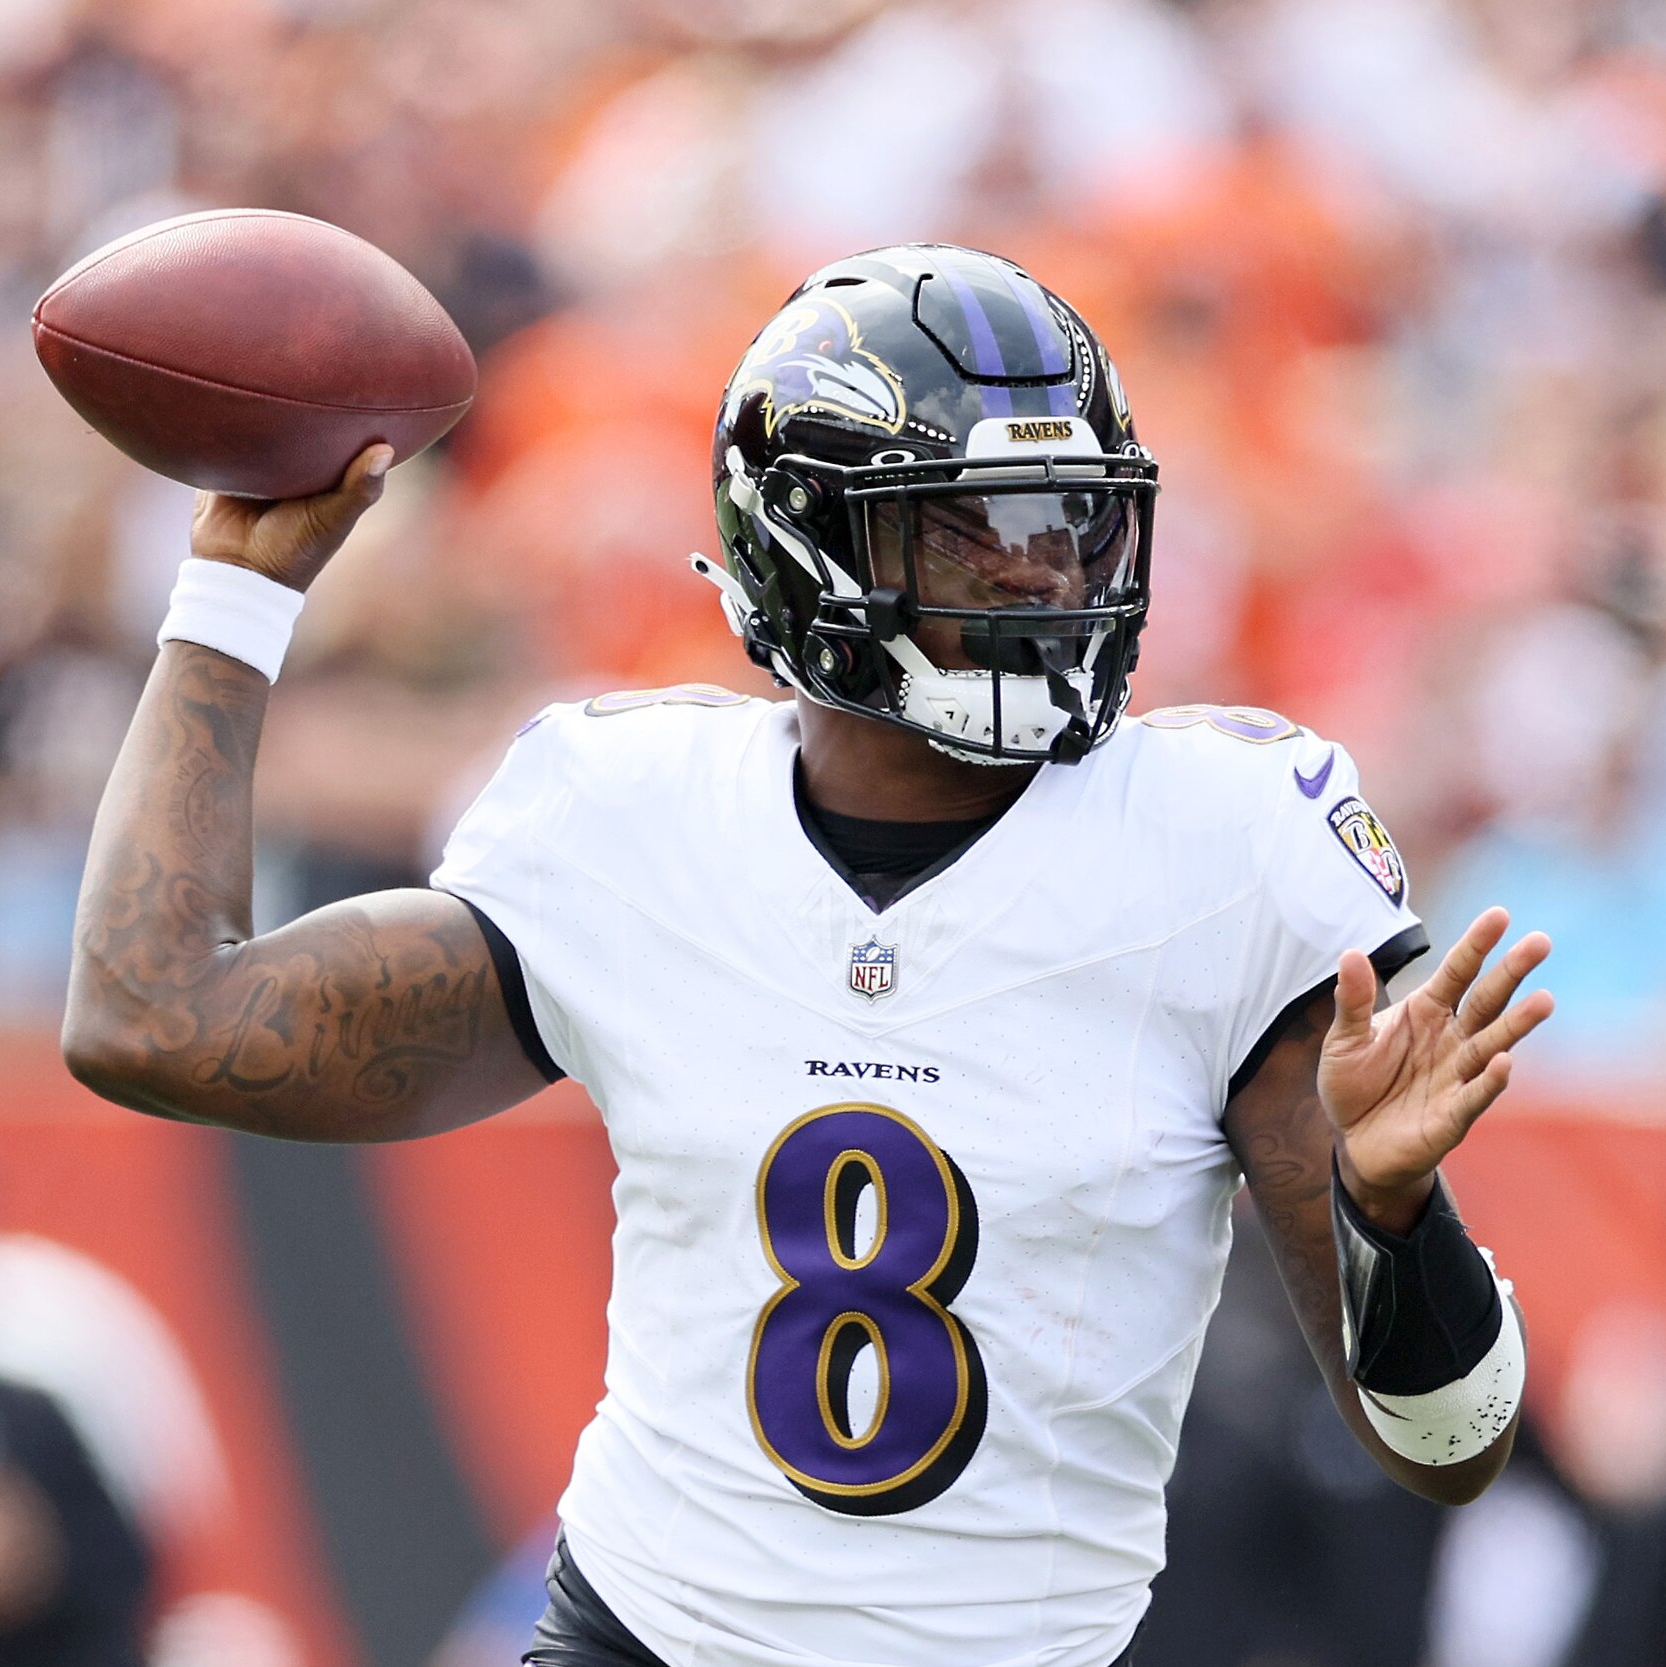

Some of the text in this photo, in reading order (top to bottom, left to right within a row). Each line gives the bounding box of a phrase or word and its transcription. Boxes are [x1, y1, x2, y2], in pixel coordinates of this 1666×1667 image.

[1006, 421, 1073, 442] RAVENS
[854, 966, 889, 990] NFL
[804, 1060, 940, 1083] RAVENS
[745, 1102, 988, 1517] 8
